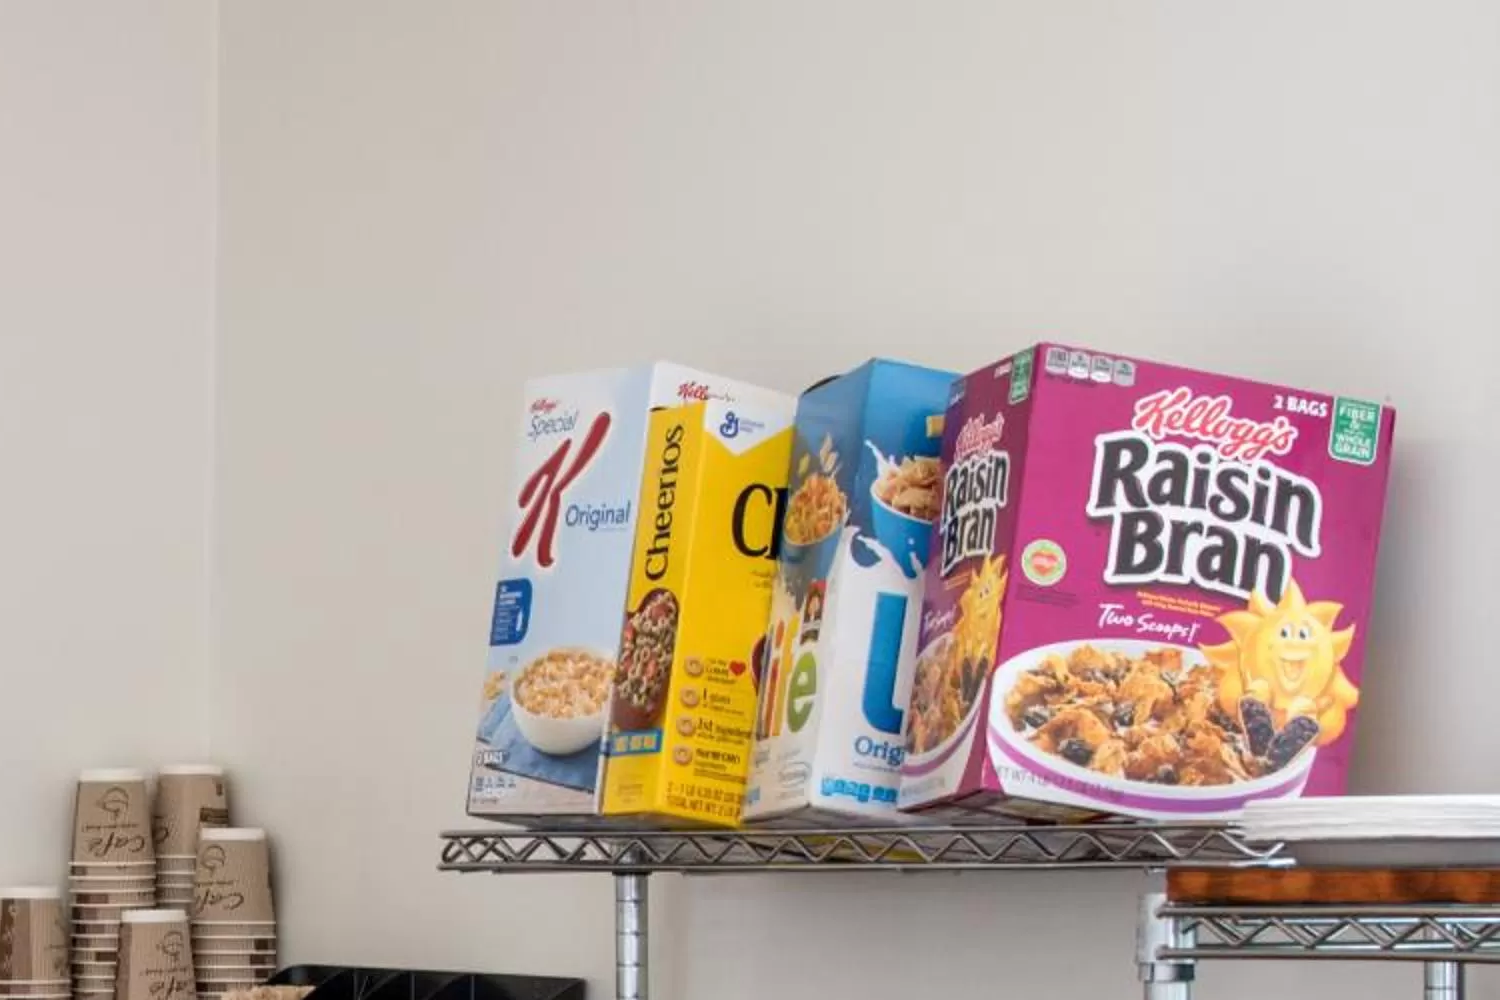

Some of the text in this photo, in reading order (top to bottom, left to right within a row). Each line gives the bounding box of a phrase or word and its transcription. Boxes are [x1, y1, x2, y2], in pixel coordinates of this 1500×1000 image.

[1134, 386, 1298, 459] Kellogg's
[1272, 394, 1328, 417] 2 BAGS
[511, 410, 611, 568] K
[565, 500, 631, 532] Original
[645, 423, 685, 581] Cheerios
[944, 451, 1009, 519] Raisin
[1091, 433, 1319, 553] Raisin
[942, 506, 995, 575] Bran
[1109, 510, 1290, 608] Bran
[1098, 603, 1133, 628] Two
[1136, 612, 1201, 643] Scoops!
